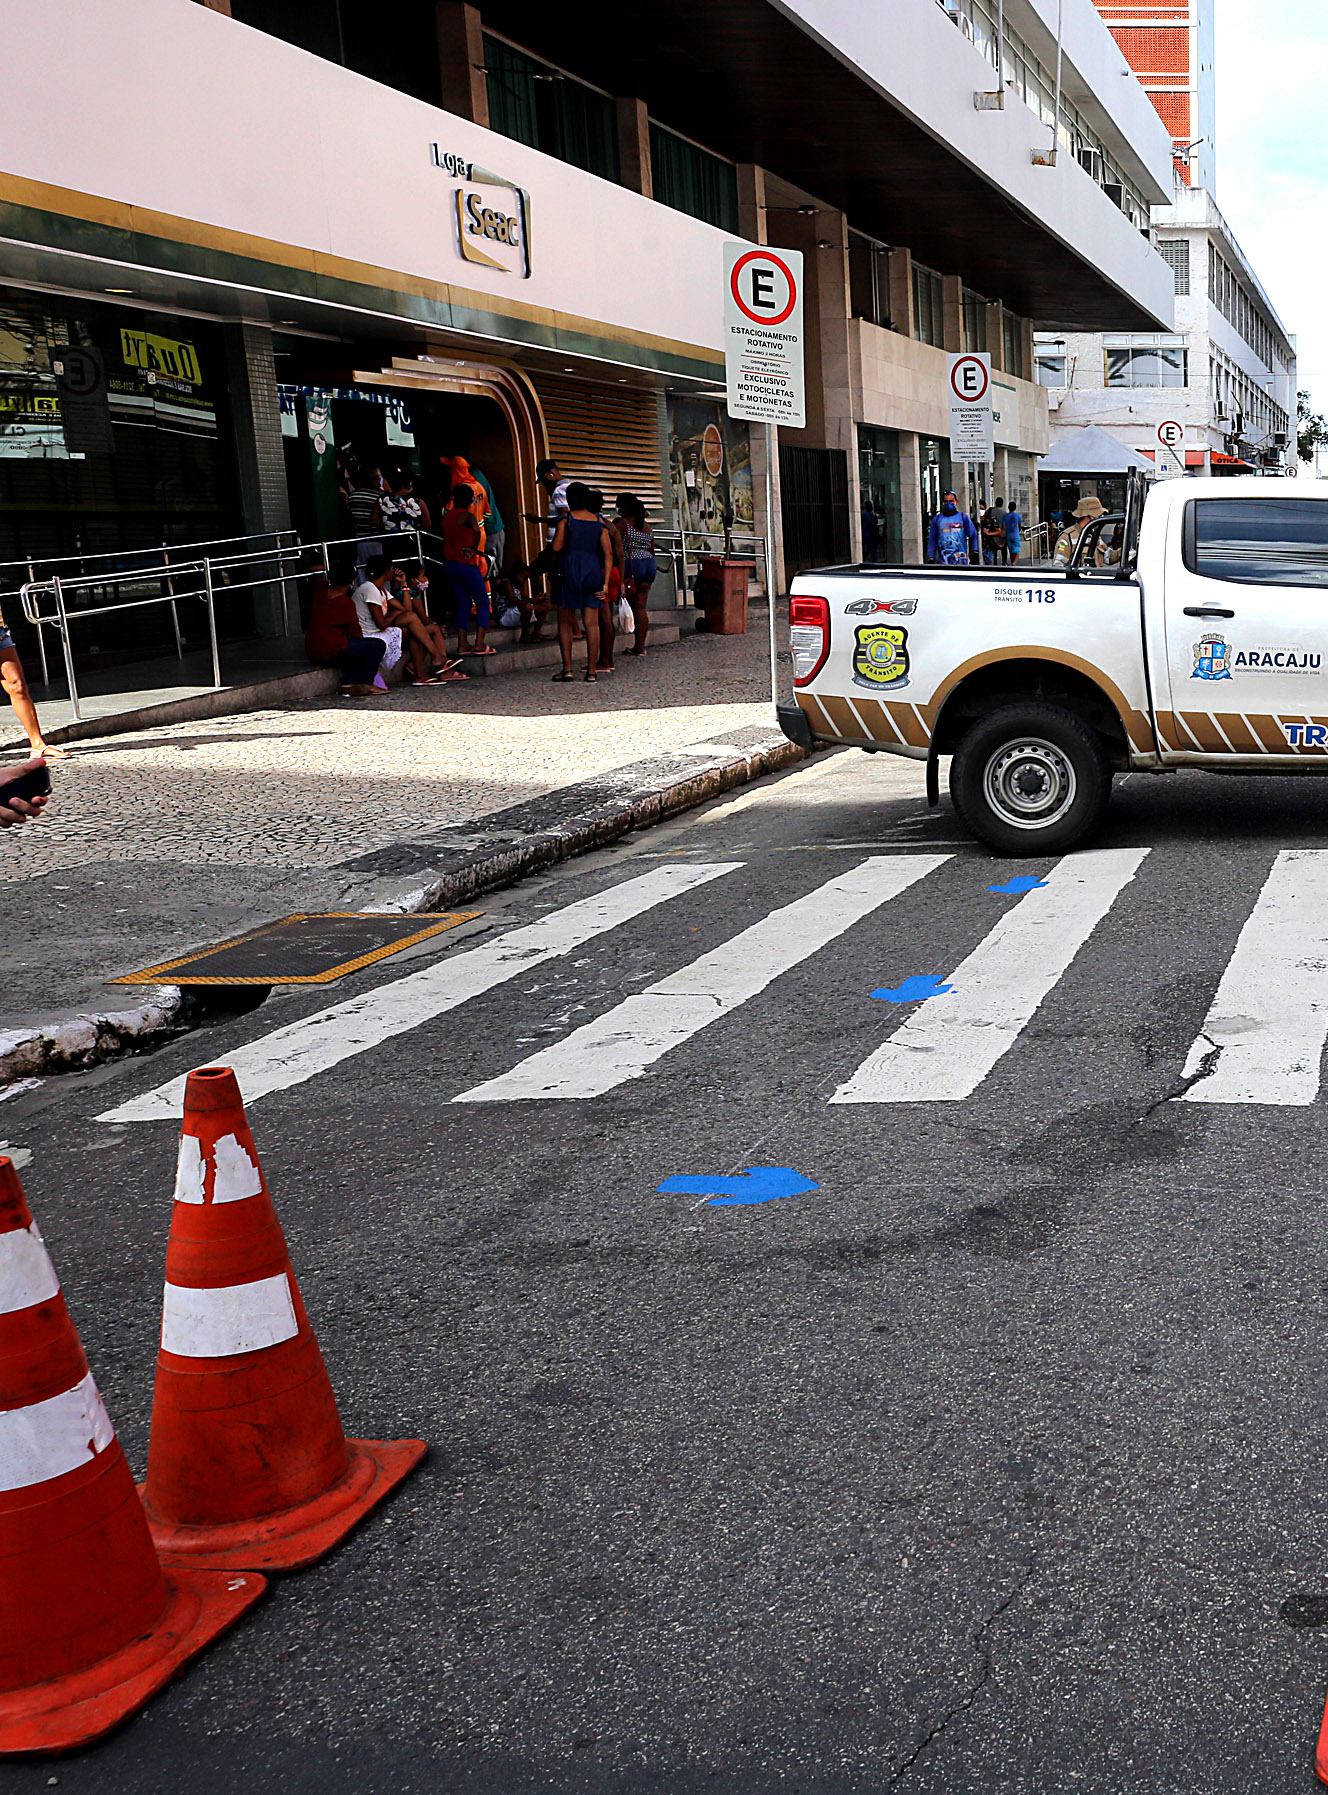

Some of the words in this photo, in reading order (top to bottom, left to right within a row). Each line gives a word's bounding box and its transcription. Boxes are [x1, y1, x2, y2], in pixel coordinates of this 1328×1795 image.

[432, 143, 466, 177] Loja
[466, 194, 519, 246] Seac
[751, 268, 776, 310] E
[731, 326, 798, 343] ESTACIONAMENTO
[747, 338, 783, 351] ROTATIVO
[744, 374, 787, 387] EXCLUSIVO
[963, 367, 978, 391] E
[737, 383, 795, 398] MOTOCICLETAS
[739, 393, 745, 401] E
[746, 394, 793, 408] MOTONETAS
[1165, 426, 1176, 440] E
[994, 588, 1023, 596] DISQUE
[1025, 589, 1056, 604] 118
[863, 631, 889, 642] AGENTE
[890, 634, 900, 644] DE
[1234, 651, 1321, 669] ARACAJU
[866, 665, 897, 676] TRÂNSITO
